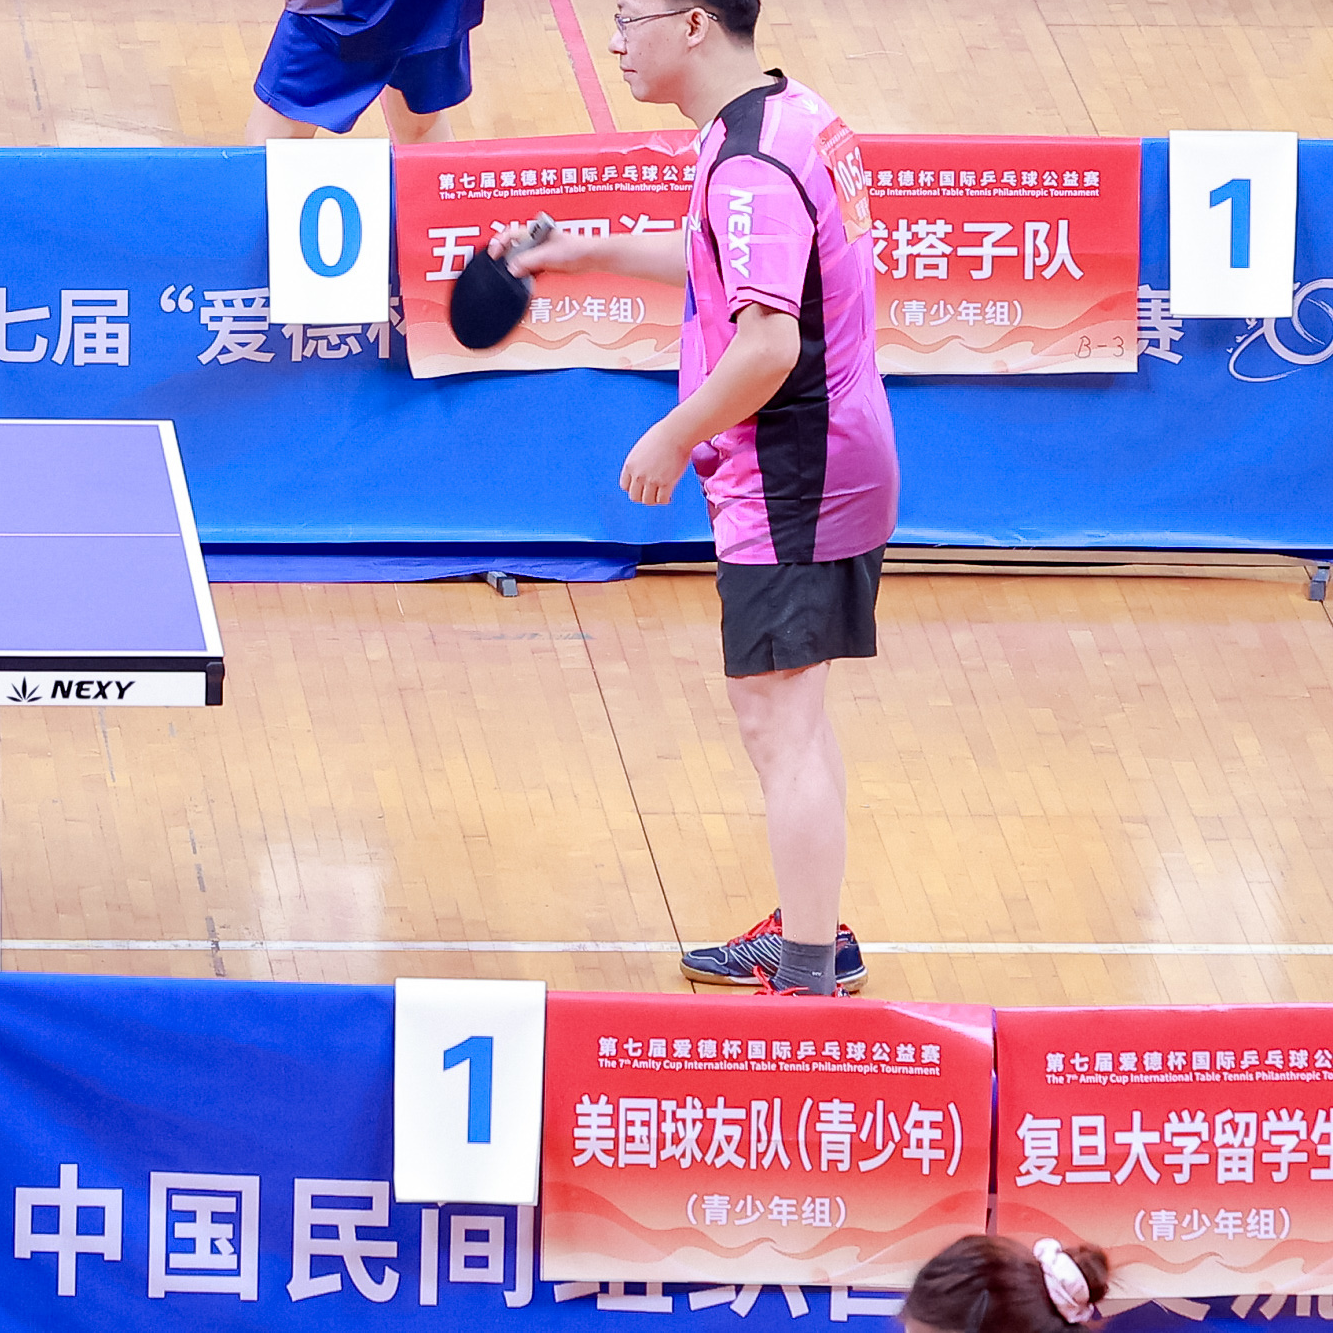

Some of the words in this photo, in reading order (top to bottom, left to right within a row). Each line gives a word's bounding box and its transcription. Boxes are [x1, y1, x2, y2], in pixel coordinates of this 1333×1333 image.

[467, 190, 491, 200] Amity
[493, 190, 509, 199] Cup
[511, 188, 563, 197] International
[565, 187, 585, 195] Table
[587, 187, 613, 195] Tennis
[615, 185, 668, 195] Philanthropic
[670, 184, 693, 192] Tourn
[870, 189, 885, 198] Cup
[993, 189, 1047, 198] Philanthropic
[299, 185, 362, 278] 0
[723, 190, 751, 278] NEXY
[1209, 178, 1251, 269] 1
[50, 679, 136, 700] NEXY
[597, 1036, 941, 1065] 第七届爱德杯国际乒乓球公益赛
[599, 1059, 616, 1068] The
[633, 1059, 661, 1071] Amity
[663, 1060, 682, 1072] Cup
[684, 1060, 749, 1071] International
[750, 1062, 776, 1071] Table
[779, 1062, 809, 1072] Tennis
[812, 1063, 878, 1075] Philanthropic
[881, 1064, 940, 1075] Tournament
[1046, 1074, 1064, 1084] The
[1079, 1073, 1107, 1086] Amity
[1109, 1073, 1128, 1085] Cup
[1130, 1072, 1193, 1083] International
[1195, 1072, 1220, 1082] Table
[1222, 1072, 1253, 1082] Tennis
[1255, 1071, 1321, 1084] Philanthropic
[442, 1035, 493, 1144] 1
[686, 1193, 848, 1228] （青少年组）
[1133, 1207, 1291, 1241] （青少年组）
